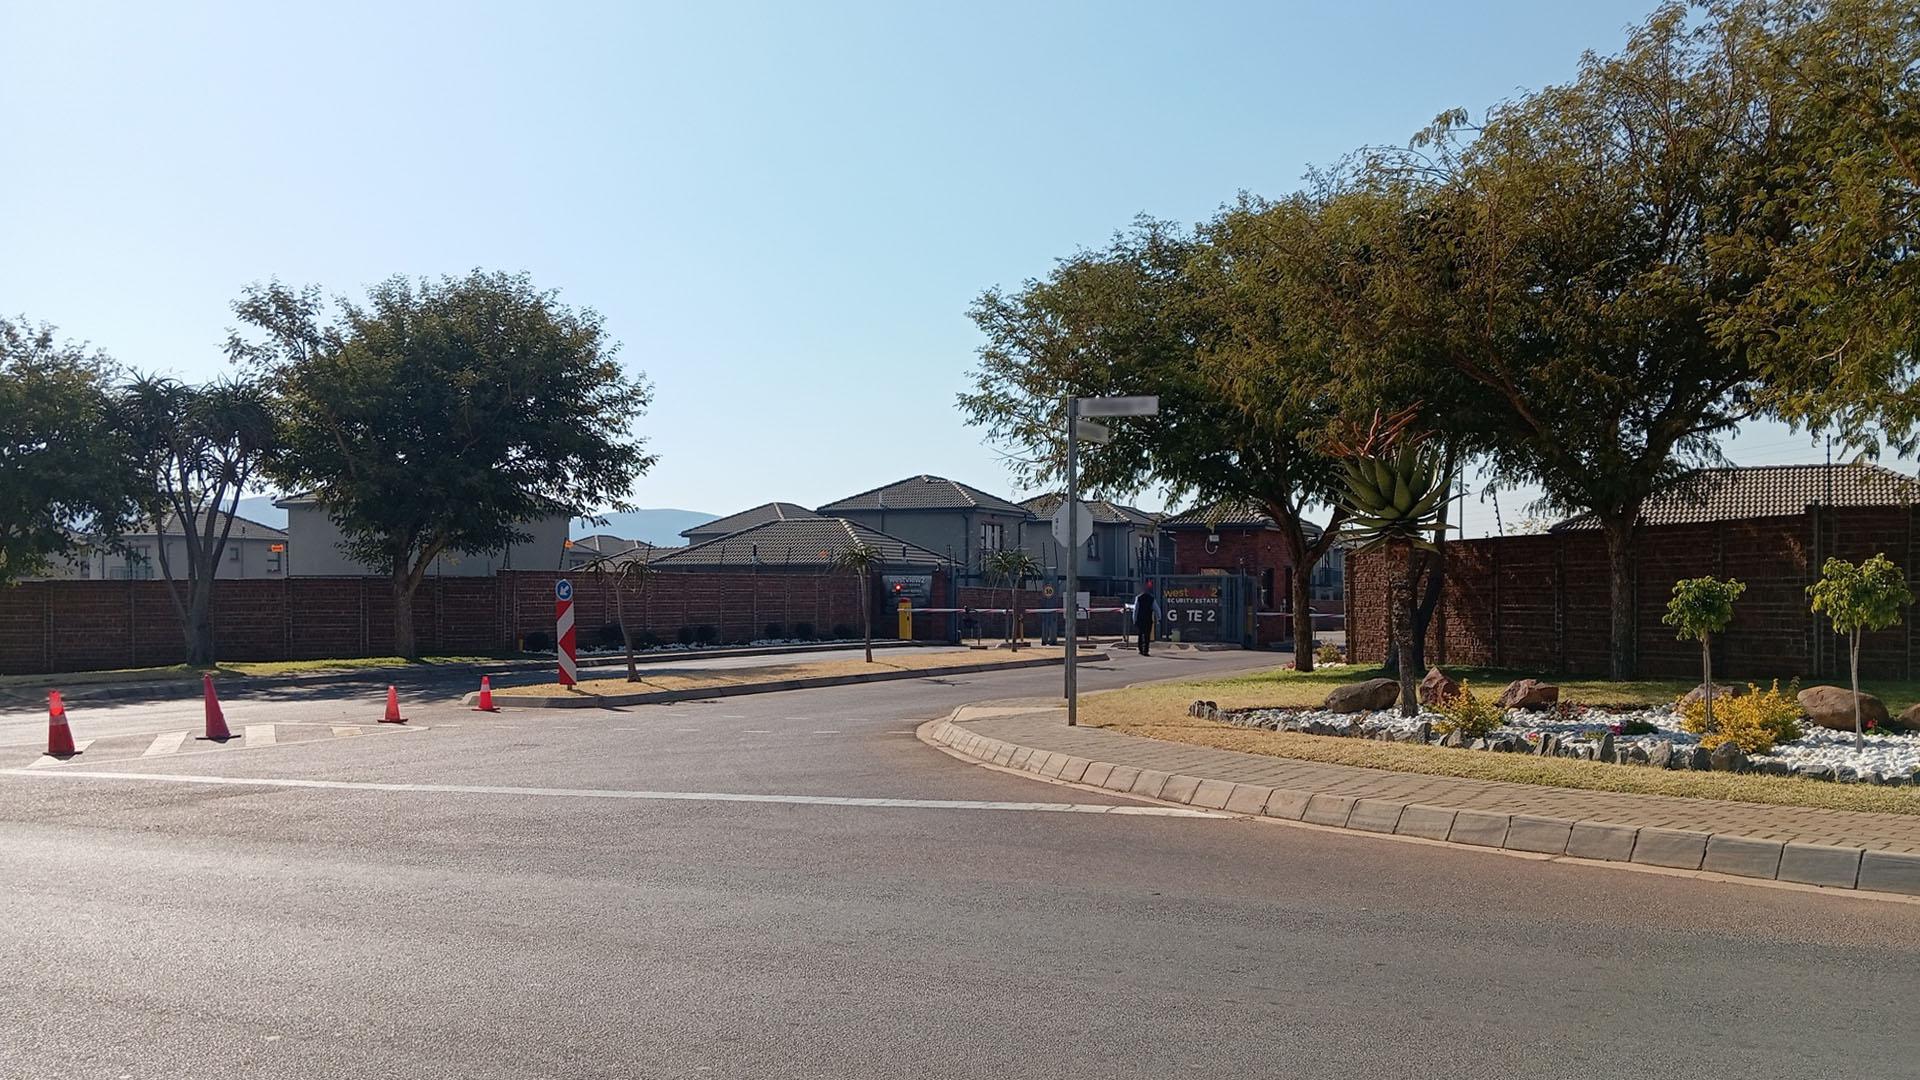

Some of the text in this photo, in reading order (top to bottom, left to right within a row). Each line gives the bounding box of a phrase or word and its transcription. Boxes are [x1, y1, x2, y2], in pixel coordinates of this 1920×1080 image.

[1163, 587, 1218, 597] west2
[1167, 609, 1216, 622] GTE 2
